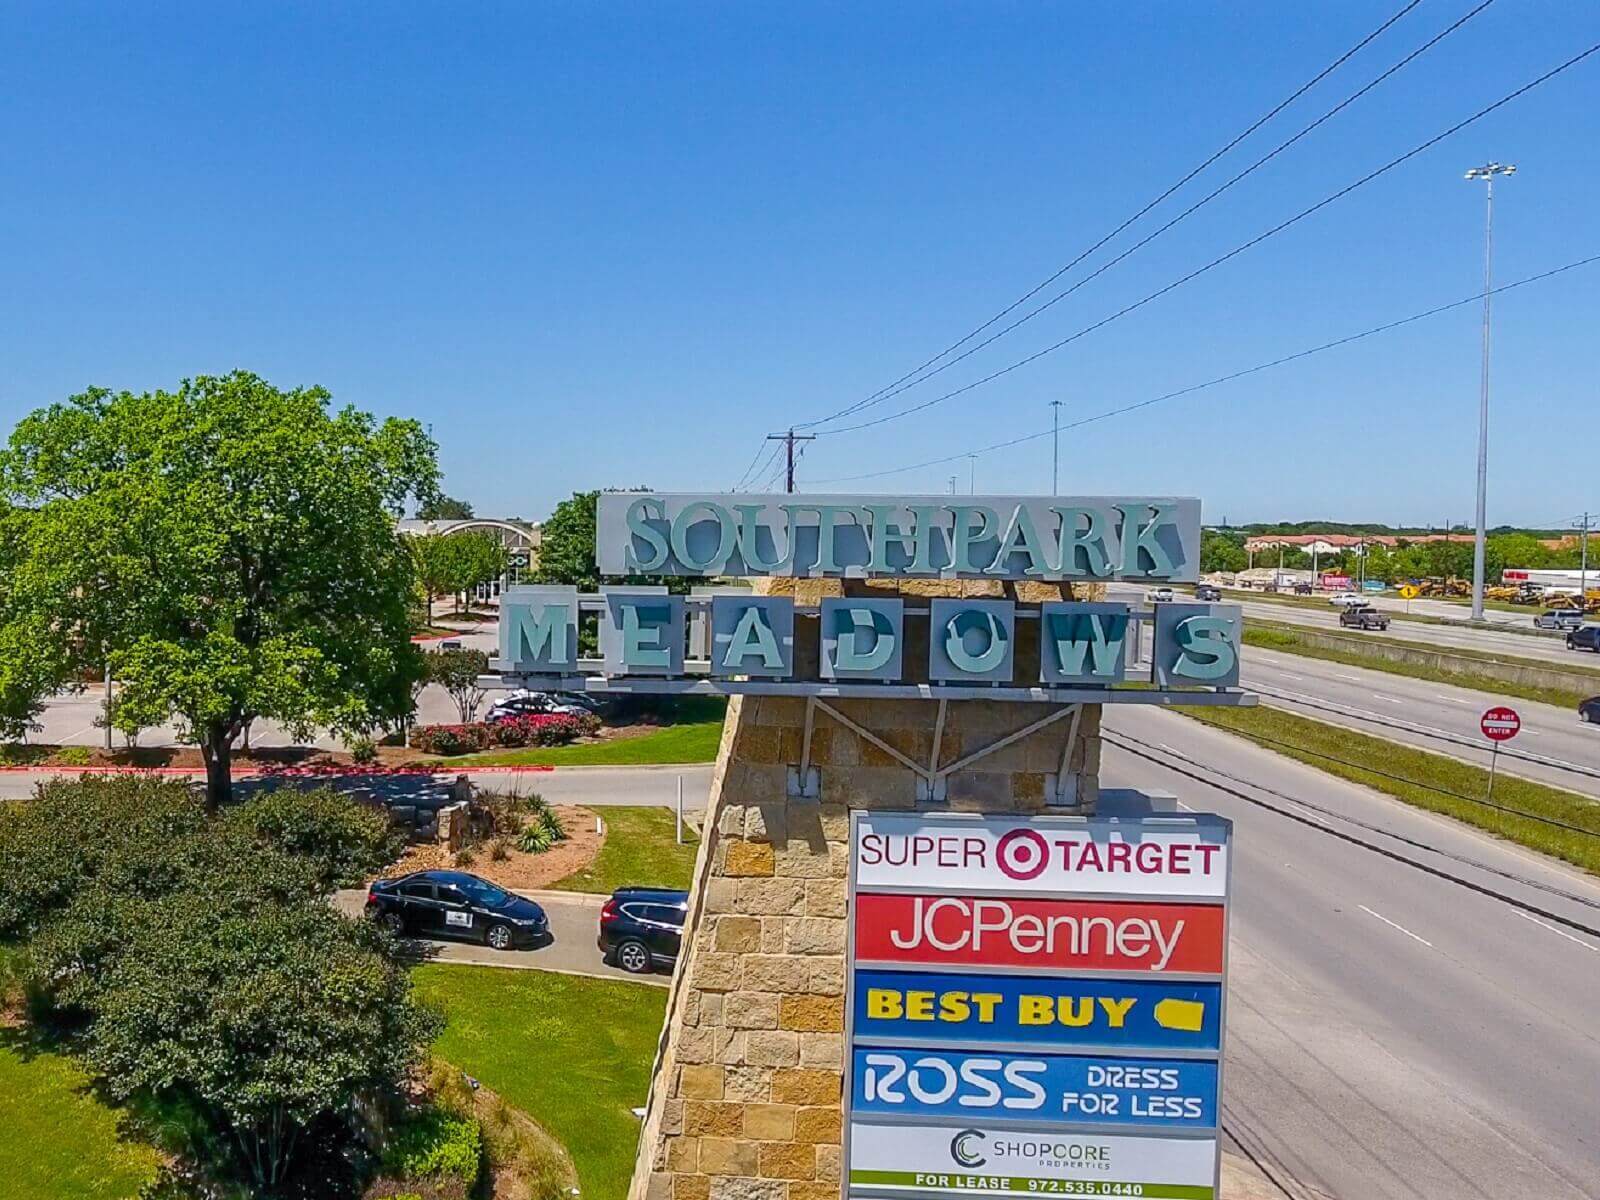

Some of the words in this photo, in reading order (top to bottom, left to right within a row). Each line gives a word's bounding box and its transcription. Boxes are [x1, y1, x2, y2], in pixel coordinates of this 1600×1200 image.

[624, 498, 1182, 580] SOUTHPARK
[508, 603, 1236, 679] MEADOWS
[1488, 727, 1511, 735] ENTER
[861, 834, 986, 869] SUPER
[1054, 840, 1220, 875] TARGET
[890, 897, 1185, 971] JCPenney
[867, 988, 1003, 1023] BEST
[1018, 995, 1137, 1028] BUY
[864, 1054, 1048, 1110] ROSS
[1087, 1065, 1178, 1089] DRESS
[1062, 1092, 1119, 1115] FOR
[1131, 1095, 1202, 1118] LESS
[994, 1141, 1111, 1161] SHOPCORE
[1039, 1160, 1111, 1171] PROPERTIES
[915, 1173, 949, 1187] FOR
[956, 1175, 1010, 1190] LEASE
[1028, 1179, 1143, 1196] 972.535.0440
